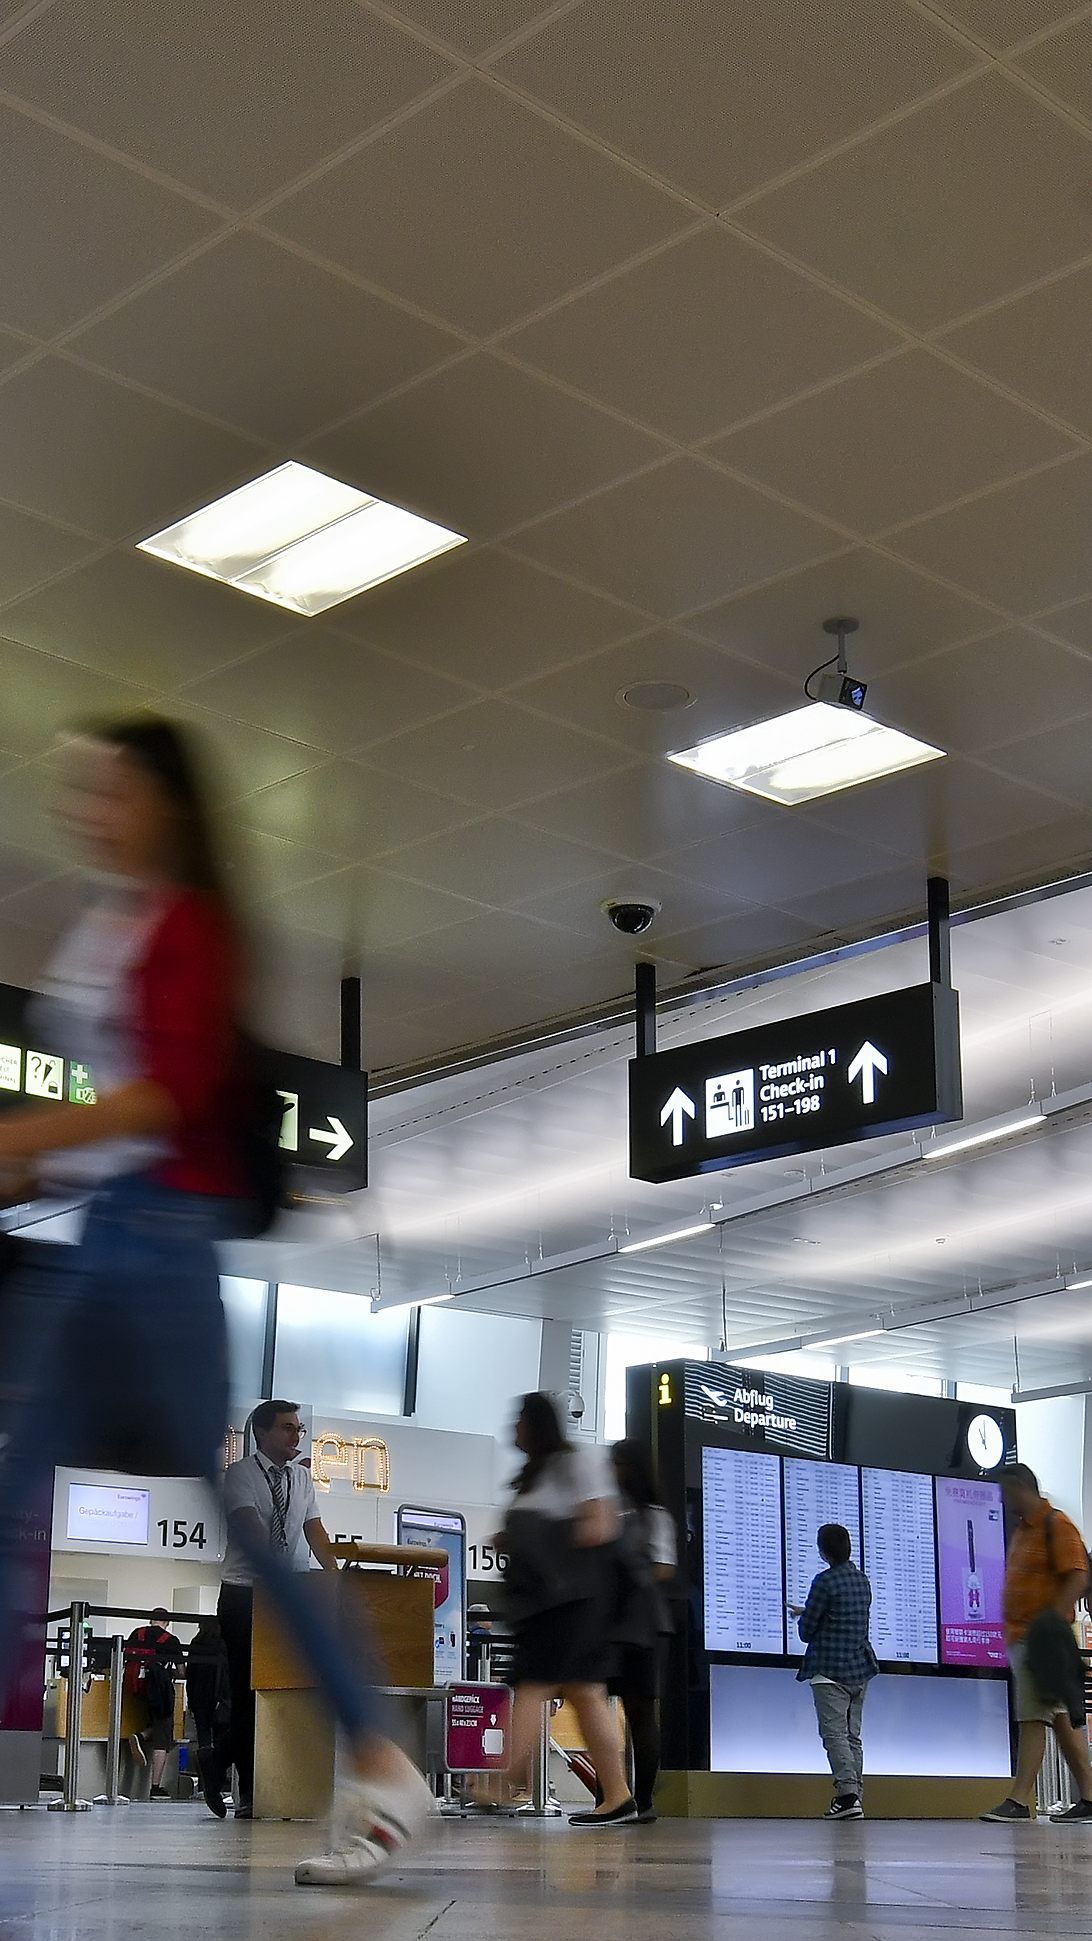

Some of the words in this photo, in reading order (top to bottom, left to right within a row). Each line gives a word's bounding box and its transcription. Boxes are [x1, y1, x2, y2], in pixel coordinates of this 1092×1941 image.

[759, 1050, 825, 1080] Terminal
[828, 1048, 837, 1064] 1
[759, 1073, 825, 1101] Check-in
[733, 1387, 774, 1411] Abflug
[733, 1407, 797, 1430] Departure
[157, 1519, 207, 1549] 154
[468, 1544, 509, 1572] 156
